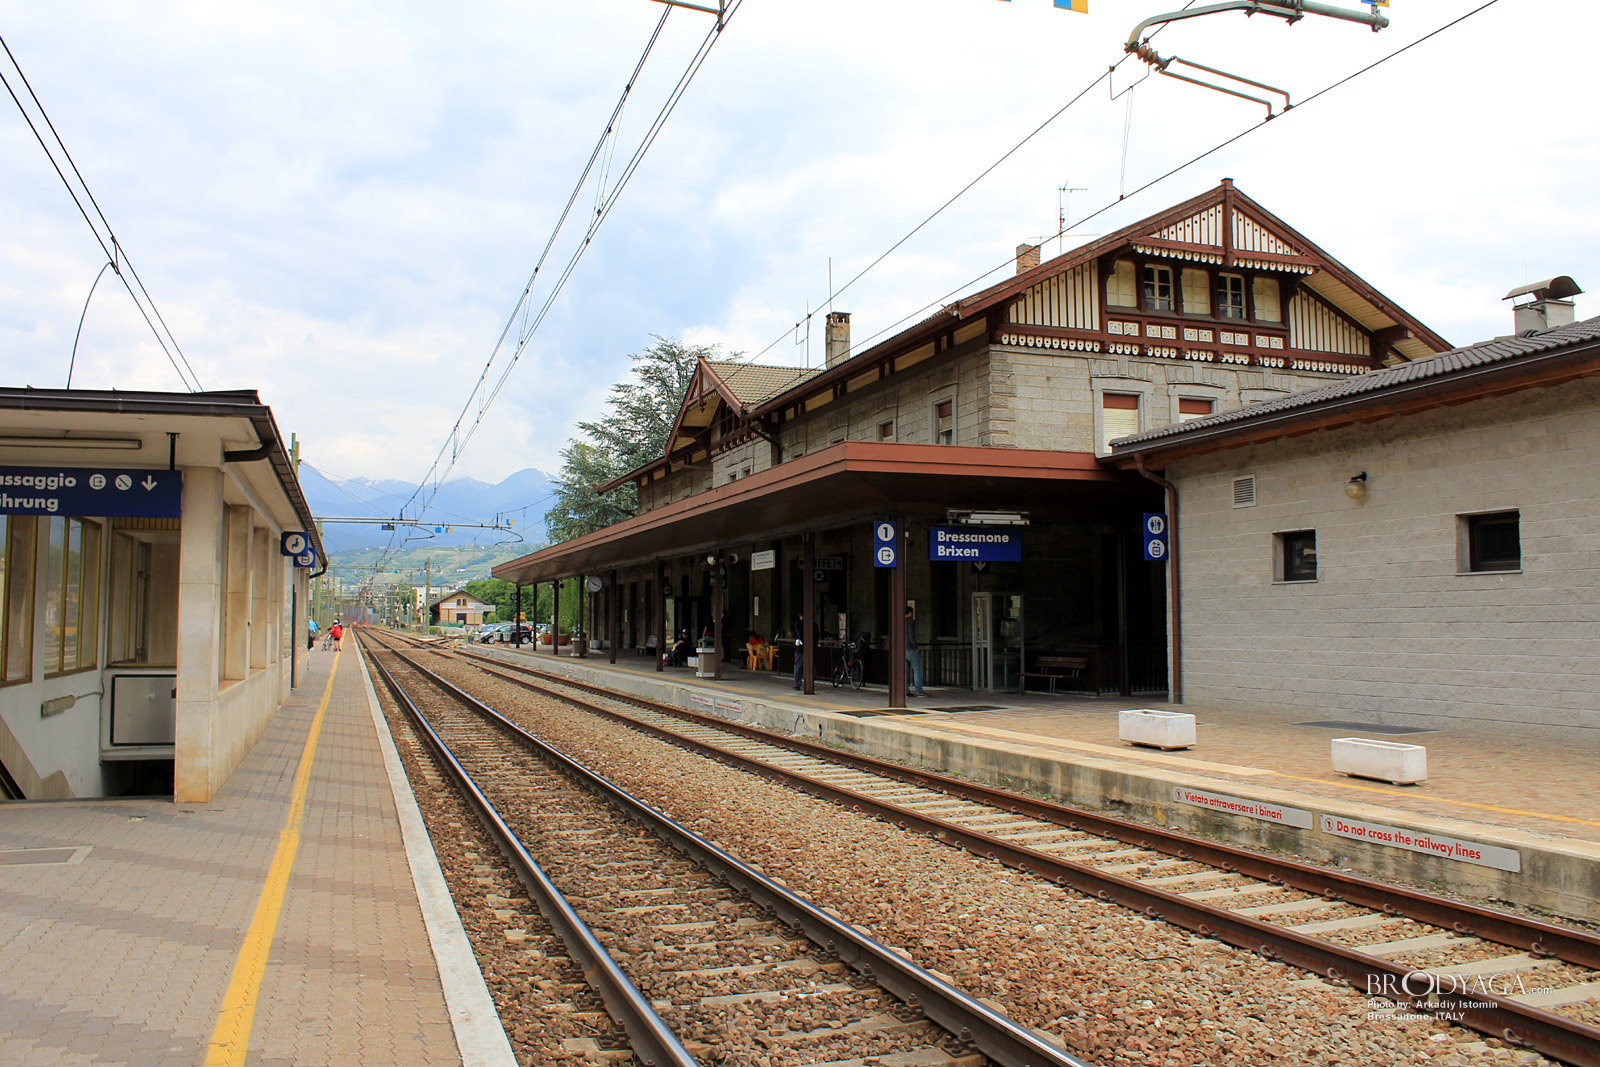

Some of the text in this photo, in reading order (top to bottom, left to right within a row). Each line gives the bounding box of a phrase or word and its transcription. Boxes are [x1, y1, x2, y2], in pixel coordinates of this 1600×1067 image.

[0, 493, 59, 512] hrung
[882, 527, 889, 539] 1
[937, 530, 1010, 543] Bressanone
[937, 545, 979, 557] Brixen
[1184, 791, 1209, 805] Vietato
[1209, 797, 1254, 814] attraversare
[1259, 805, 1282, 820] binari
[1336, 821, 1481, 860] Do not cross the railway lines
